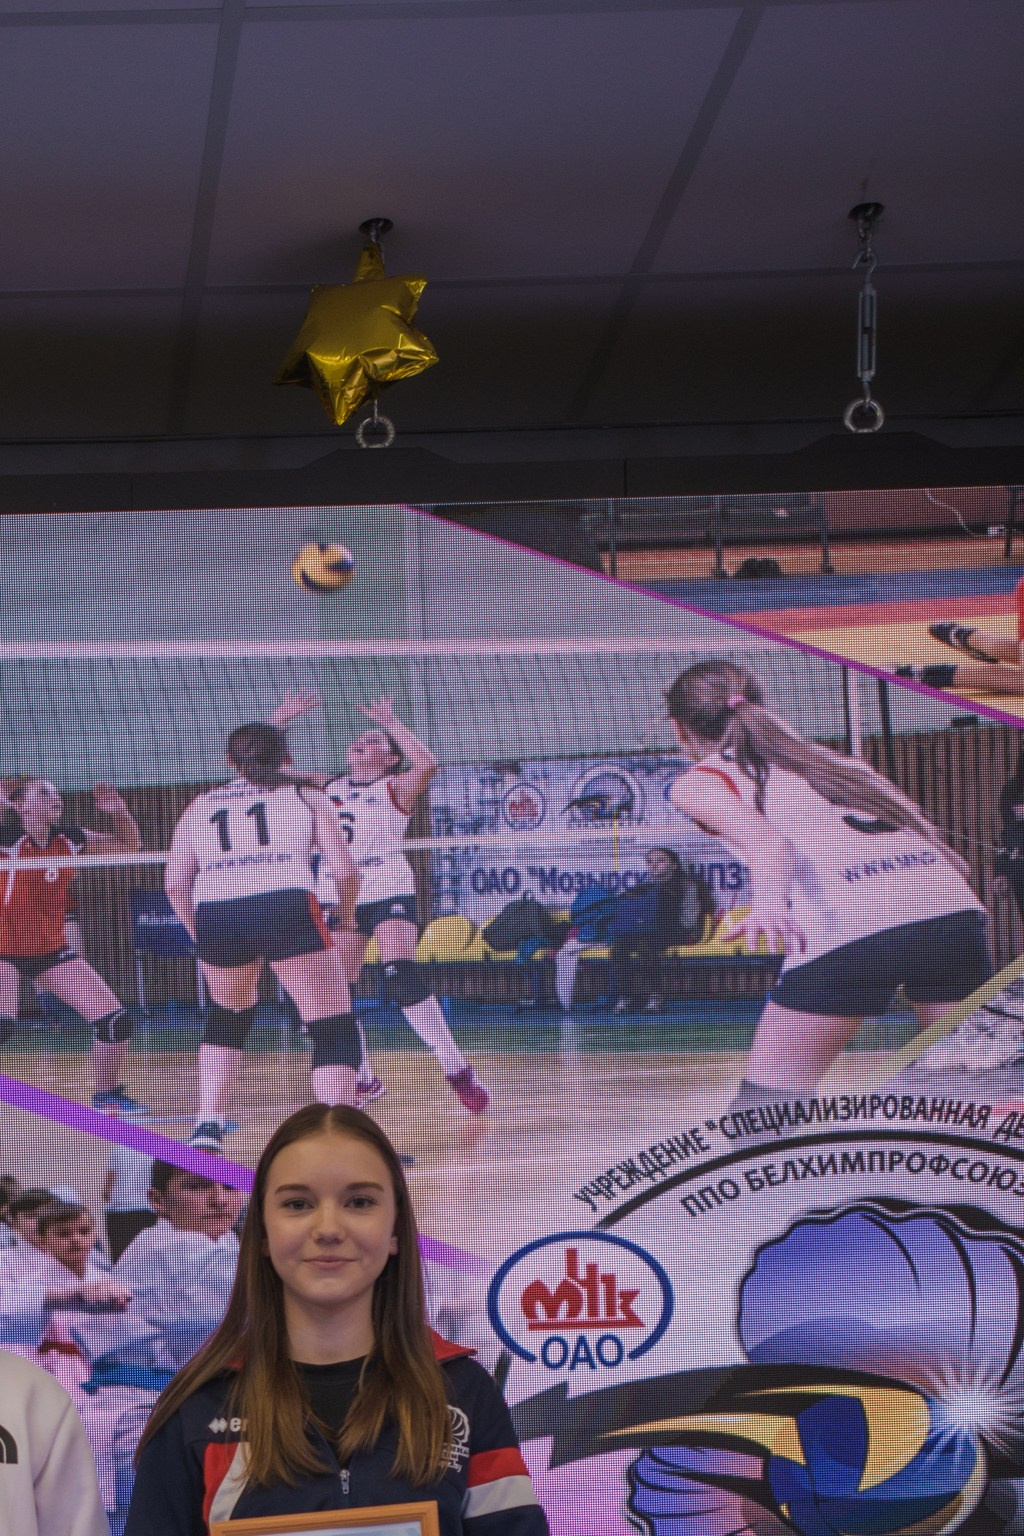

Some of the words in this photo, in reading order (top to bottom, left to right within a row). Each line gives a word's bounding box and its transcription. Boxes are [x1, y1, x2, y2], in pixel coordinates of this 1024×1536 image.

[209, 801, 270, 852] 11
[471, 867, 521, 895] ОАО
[574, 1127, 711, 1213] УЧРЕЖДЕНИЕ
[680, 1178, 741, 1217] ППО
[541, 1333, 625, 1370] ОАО
